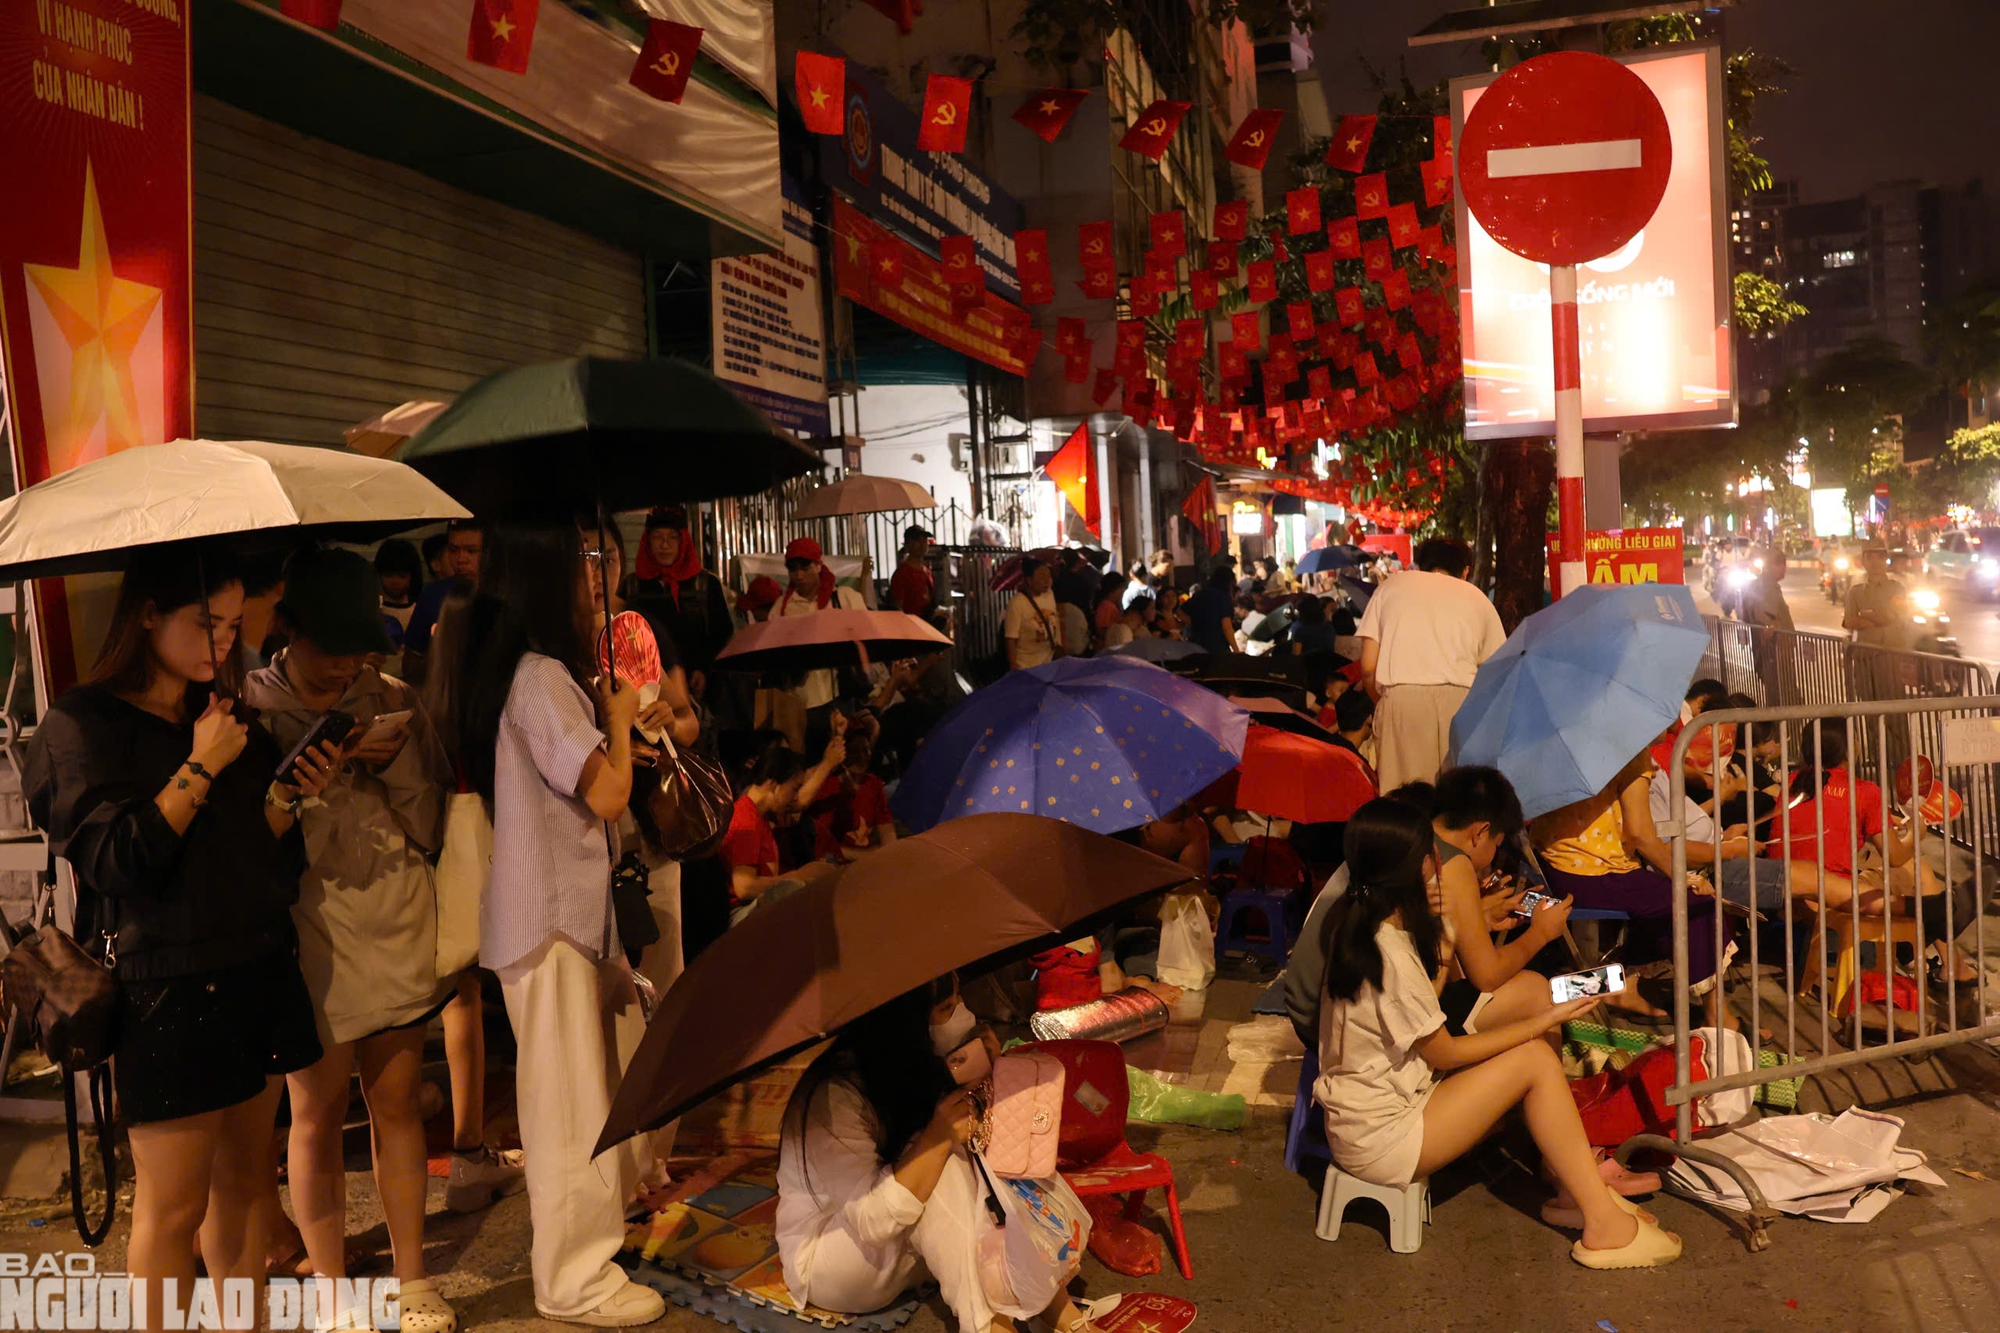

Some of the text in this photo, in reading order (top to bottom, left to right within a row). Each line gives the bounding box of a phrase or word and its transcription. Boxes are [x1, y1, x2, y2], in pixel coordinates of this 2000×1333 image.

[54, 1, 95, 53] HẠNH
[96, 17, 133, 66] PHÚC
[33, 46, 64, 106] CỦA
[65, 69, 106, 120] NHÂN
[107, 80, 136, 129] DÂN
[1585, 535, 1622, 551] HƯỜNG
[1625, 532, 1649, 549] LIỄU
[1652, 534, 1677, 549] GIAI
[1592, 553, 1659, 585] ẤM
